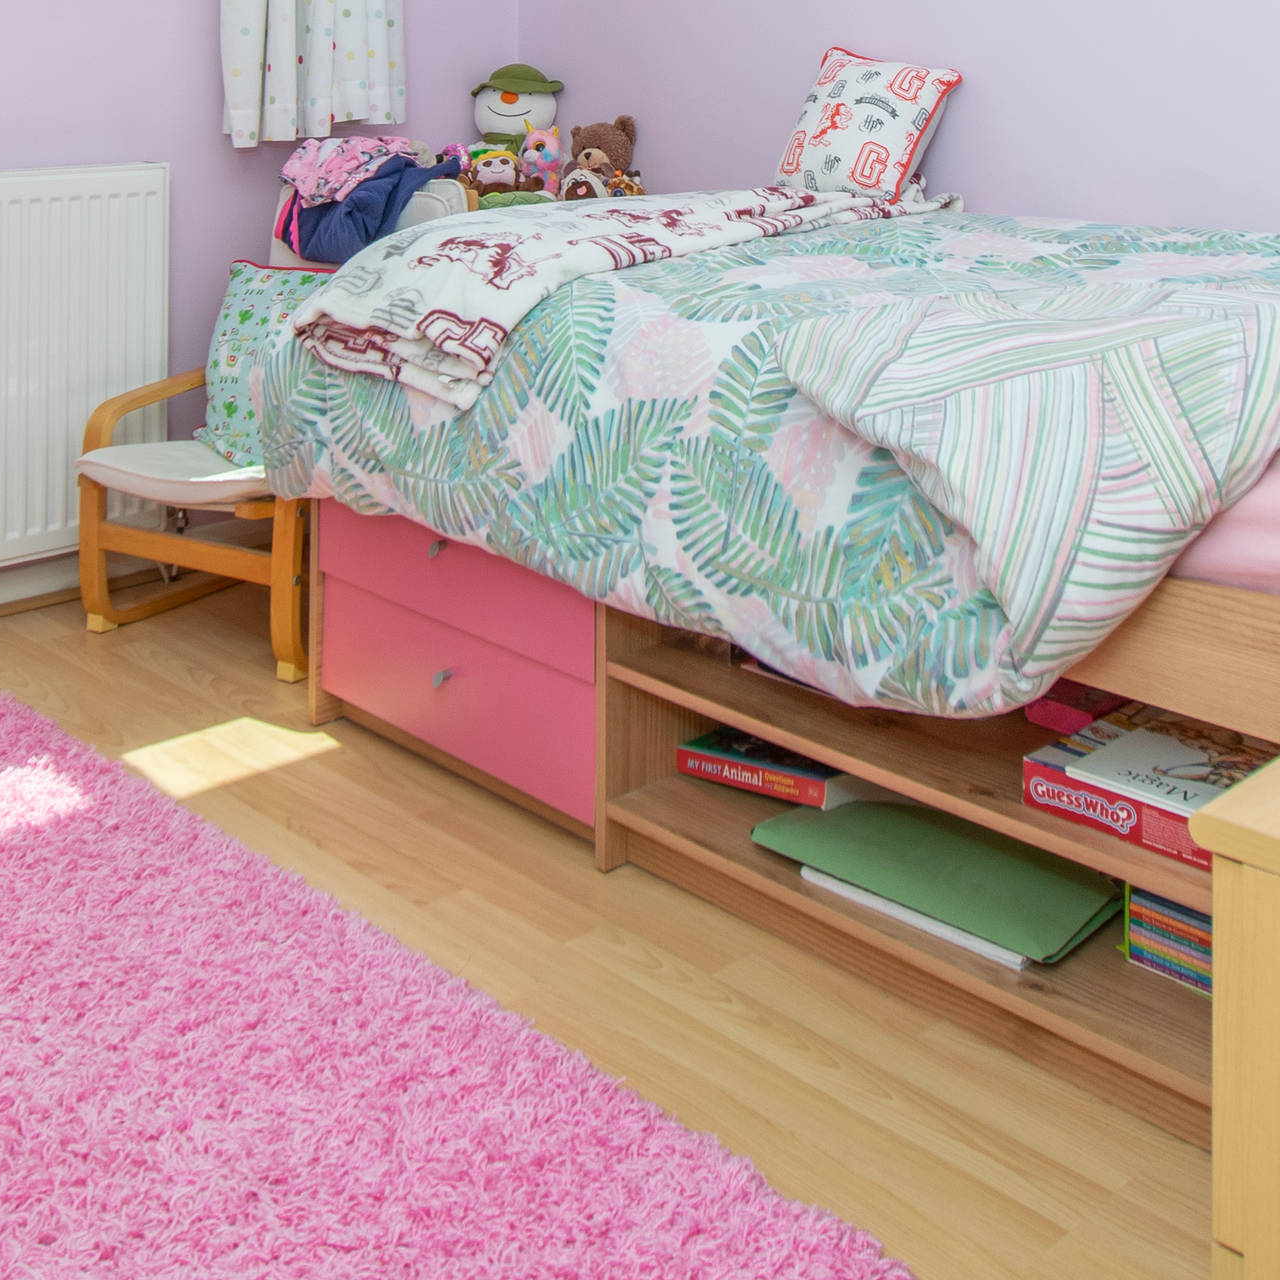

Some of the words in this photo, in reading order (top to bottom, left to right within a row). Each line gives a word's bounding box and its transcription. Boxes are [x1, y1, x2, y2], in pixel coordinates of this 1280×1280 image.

[687, 758, 700, 770] MY
[701, 762, 722, 776] FIRST
[722, 763, 764, 787] Animal
